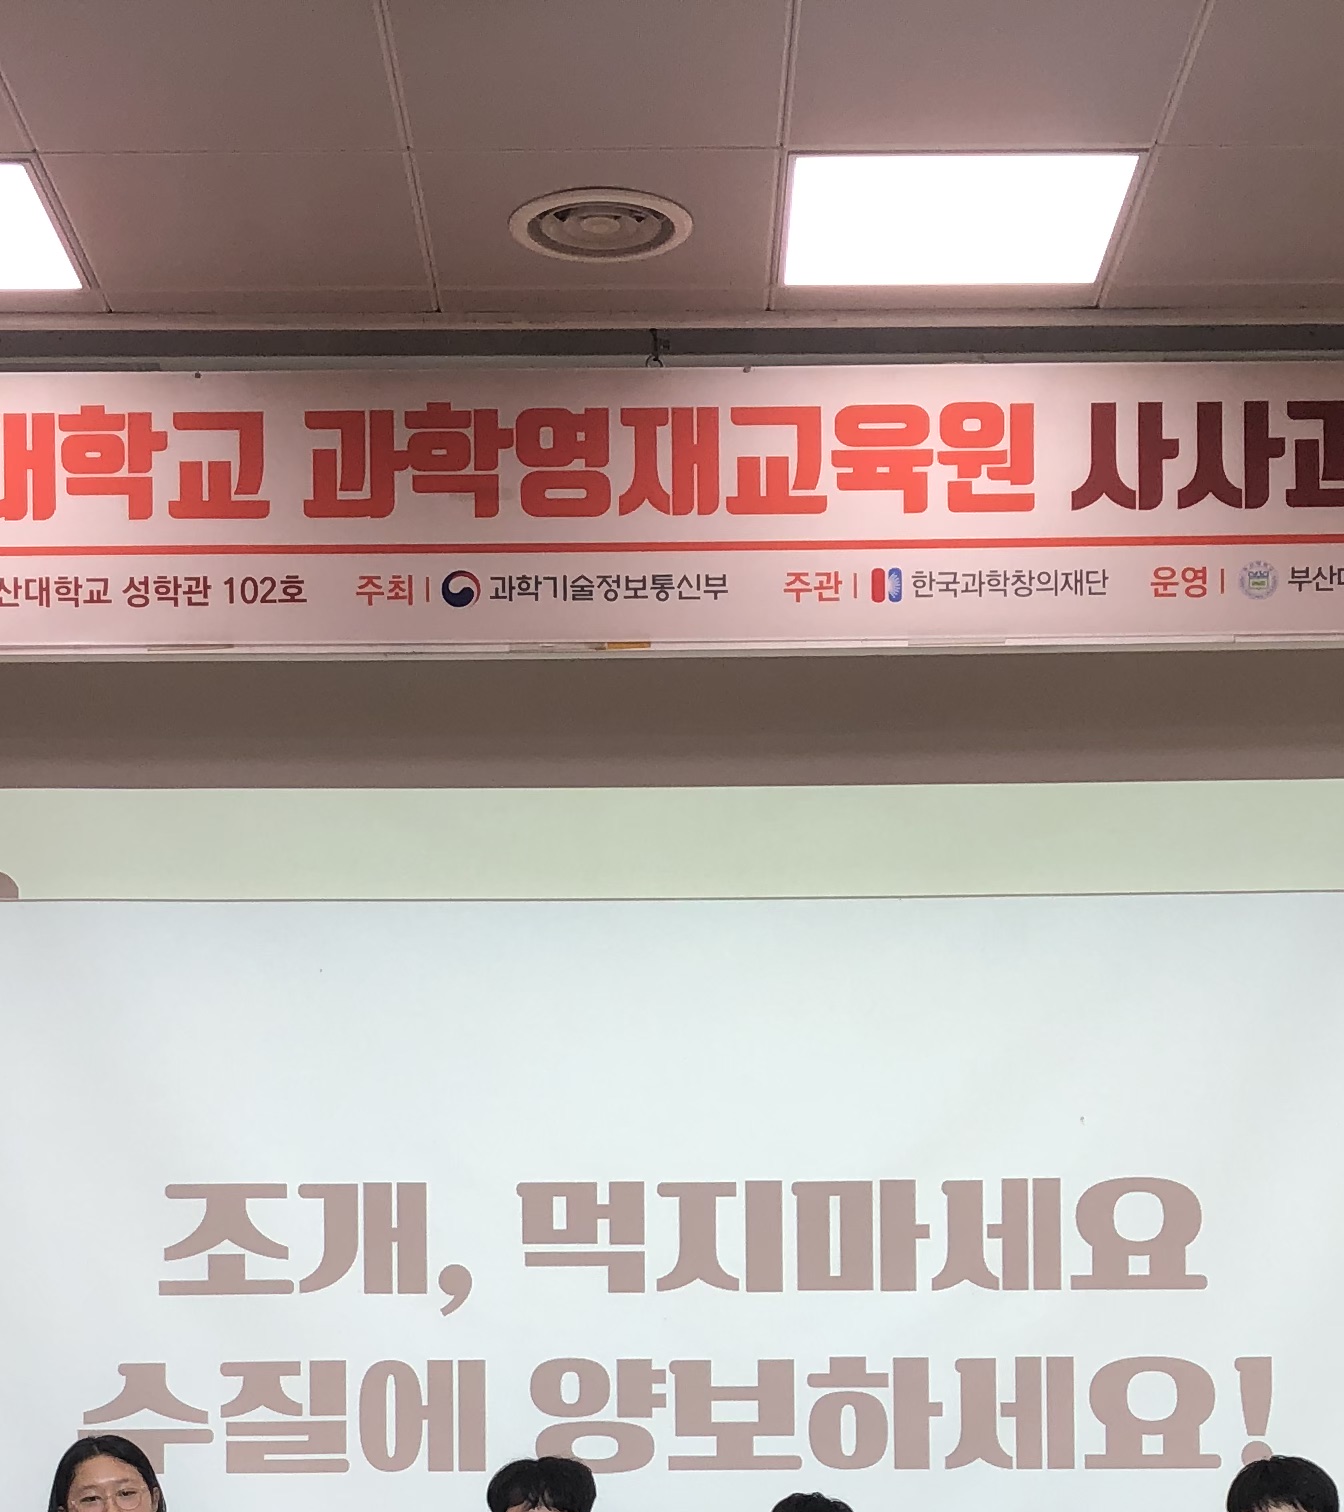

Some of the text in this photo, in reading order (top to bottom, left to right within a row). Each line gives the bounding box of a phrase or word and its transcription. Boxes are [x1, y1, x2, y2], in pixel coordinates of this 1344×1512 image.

[304, 402, 1035, 519] 과학영재교육원
[122, 576, 212, 609] 성학관
[224, 576, 307, 608] 102호
[354, 575, 415, 608] 주최
[489, 572, 729, 604] 과학기술정보통신부
[783, 570, 842, 603] 주관
[911, 567, 1109, 600] 한국과학창의재단
[1150, 567, 1209, 599] 운영
[158, 1176, 1208, 1317] 조개, 먹지마세요
[77, 1354, 1275, 1476] 수질에 양보하세요!
